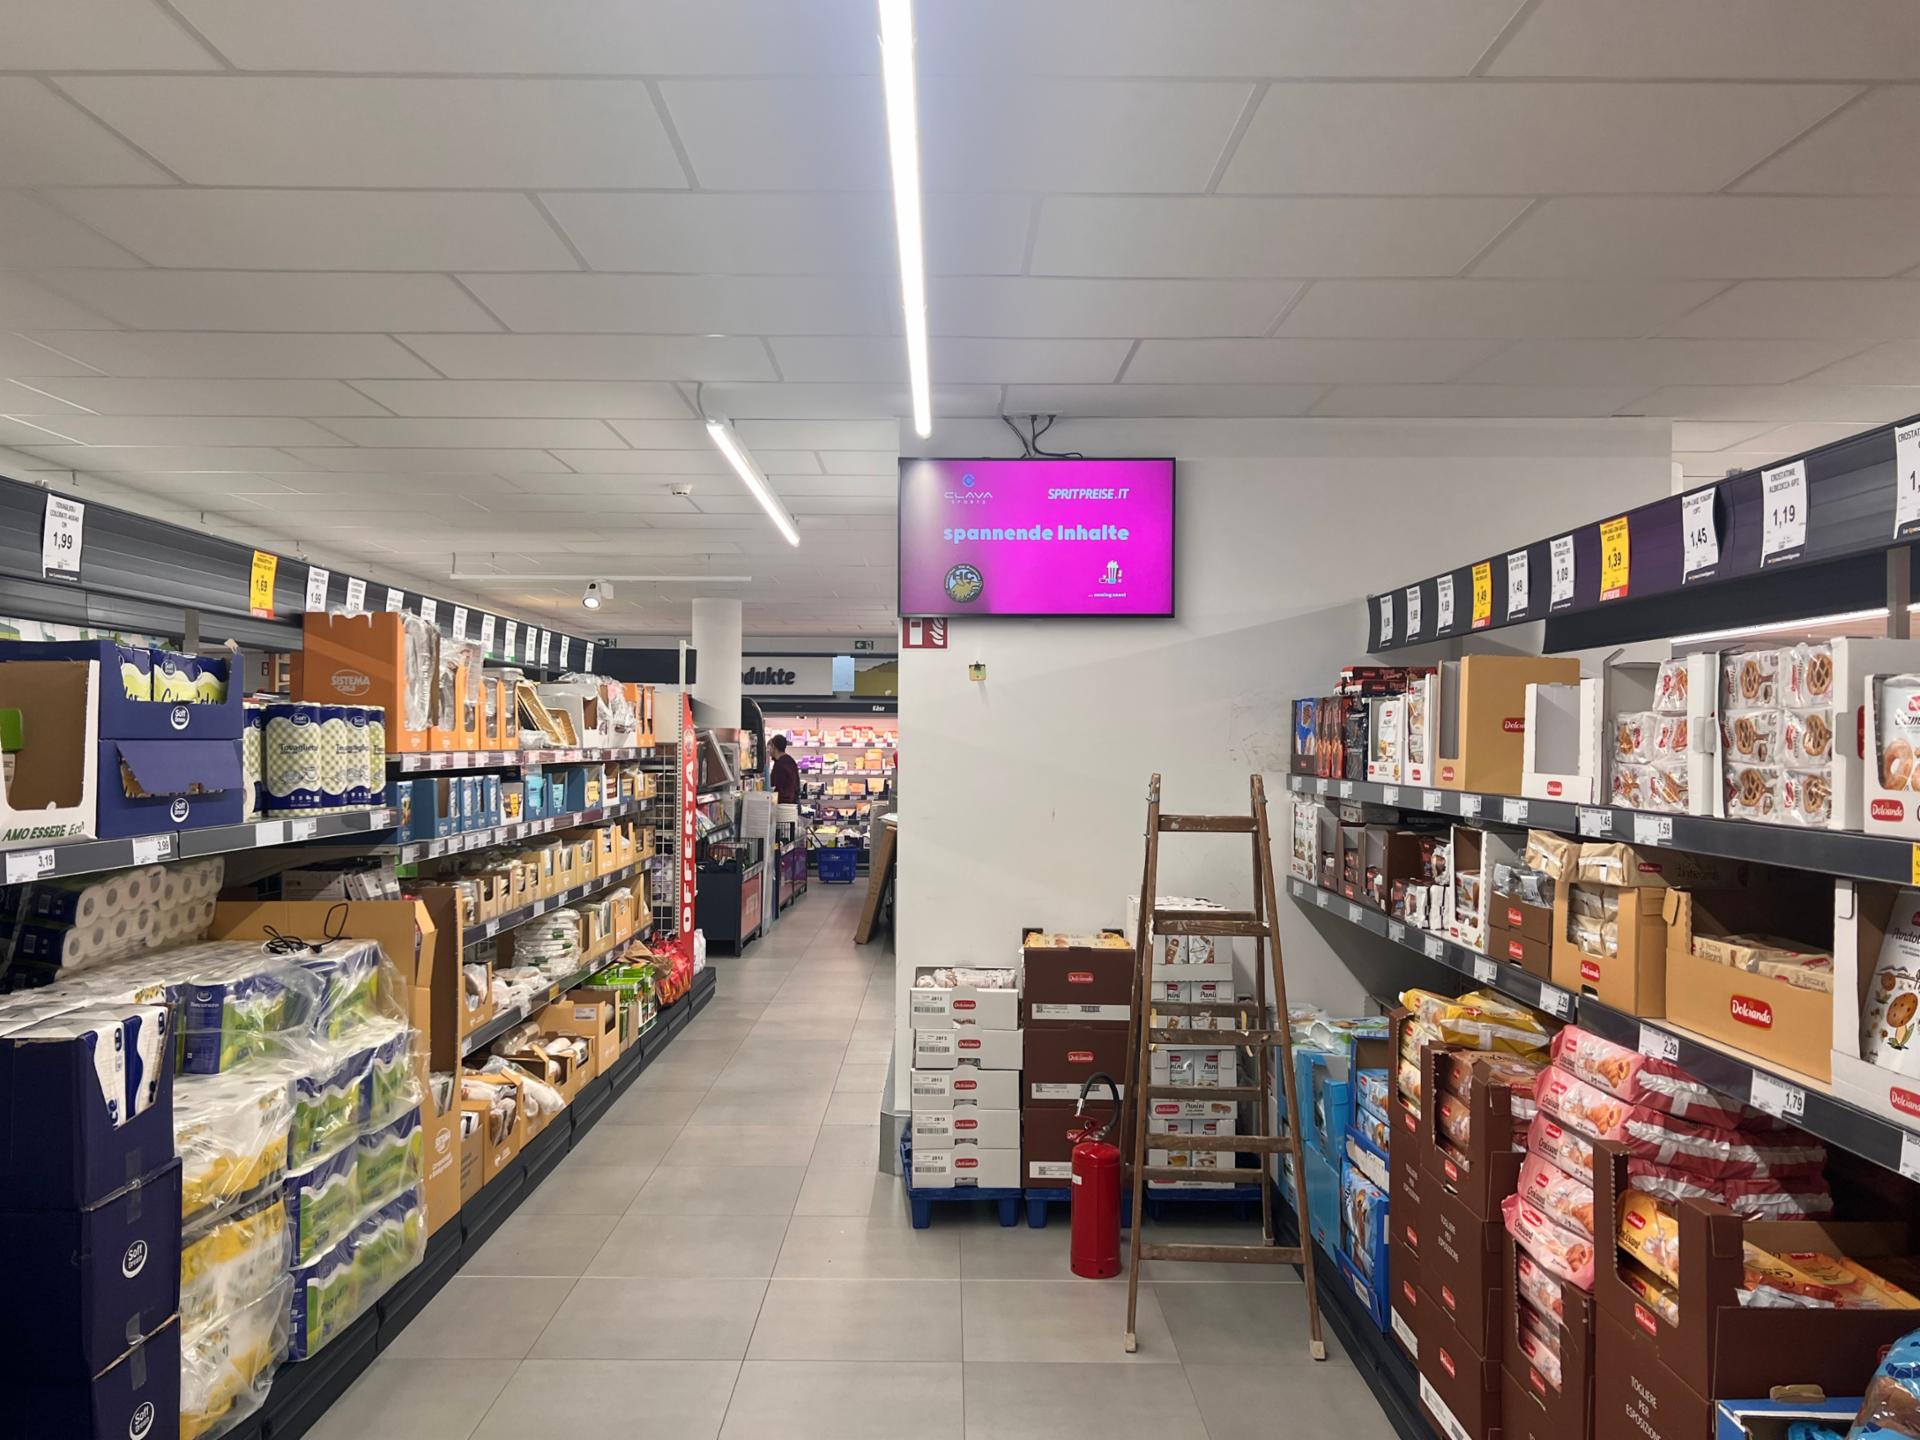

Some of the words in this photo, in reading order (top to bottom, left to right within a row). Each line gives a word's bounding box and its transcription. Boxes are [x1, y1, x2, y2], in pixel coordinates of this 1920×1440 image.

[1047, 488, 1130, 500] SPRITPREISE.IT
[1773, 505, 1796, 528] 1,19
[53, 532, 73, 550] 1,99
[943, 524, 1054, 545] spannende
[1058, 524, 1130, 541] Inhalte
[1690, 527, 1708, 549] 1,45
[742, 667, 796, 685] dukte
[175, 709, 186, 717] Soft
[174, 801, 186, 810] Soft
[1871, 803, 1903, 817] Dolciando
[2, 828, 30, 842] AMO
[30, 825, 66, 838] ESSERE
[1657, 822, 1671, 835] 1,59
[682, 759, 695, 934] OFFERTA
[38, 854, 53, 868] 3,19
[1732, 1000, 1771, 1024] Dolciando
[1785, 1092, 1803, 1113] 1,79
[128, 1243, 143, 1261] Soft
[1631, 1375, 1657, 1410] TOGLIERE
[134, 1404, 149, 1424] Soft
[1638, 1399, 1650, 1419] PER
